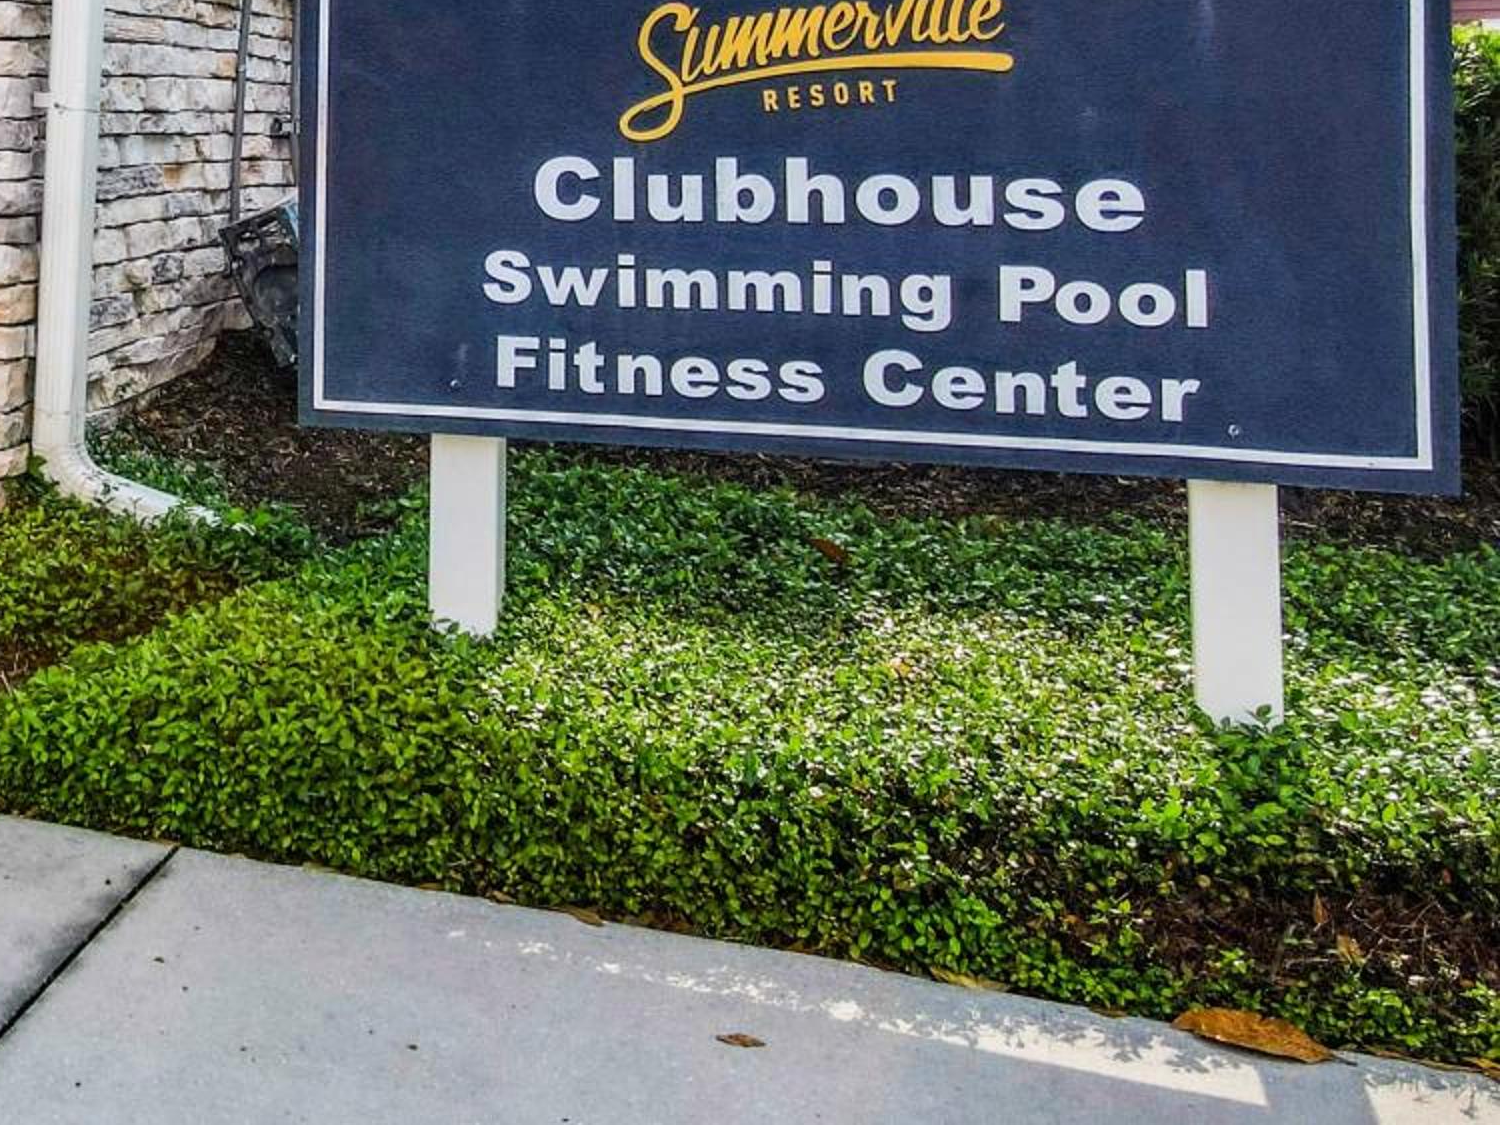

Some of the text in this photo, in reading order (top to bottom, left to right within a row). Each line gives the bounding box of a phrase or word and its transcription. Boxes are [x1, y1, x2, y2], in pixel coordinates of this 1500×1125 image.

[763, 80, 896, 111] RESORT
[534, 155, 1146, 232] Clubhouse
[482, 249, 1208, 332] Swimming Pool
[496, 334, 1201, 422] Fitness Center
